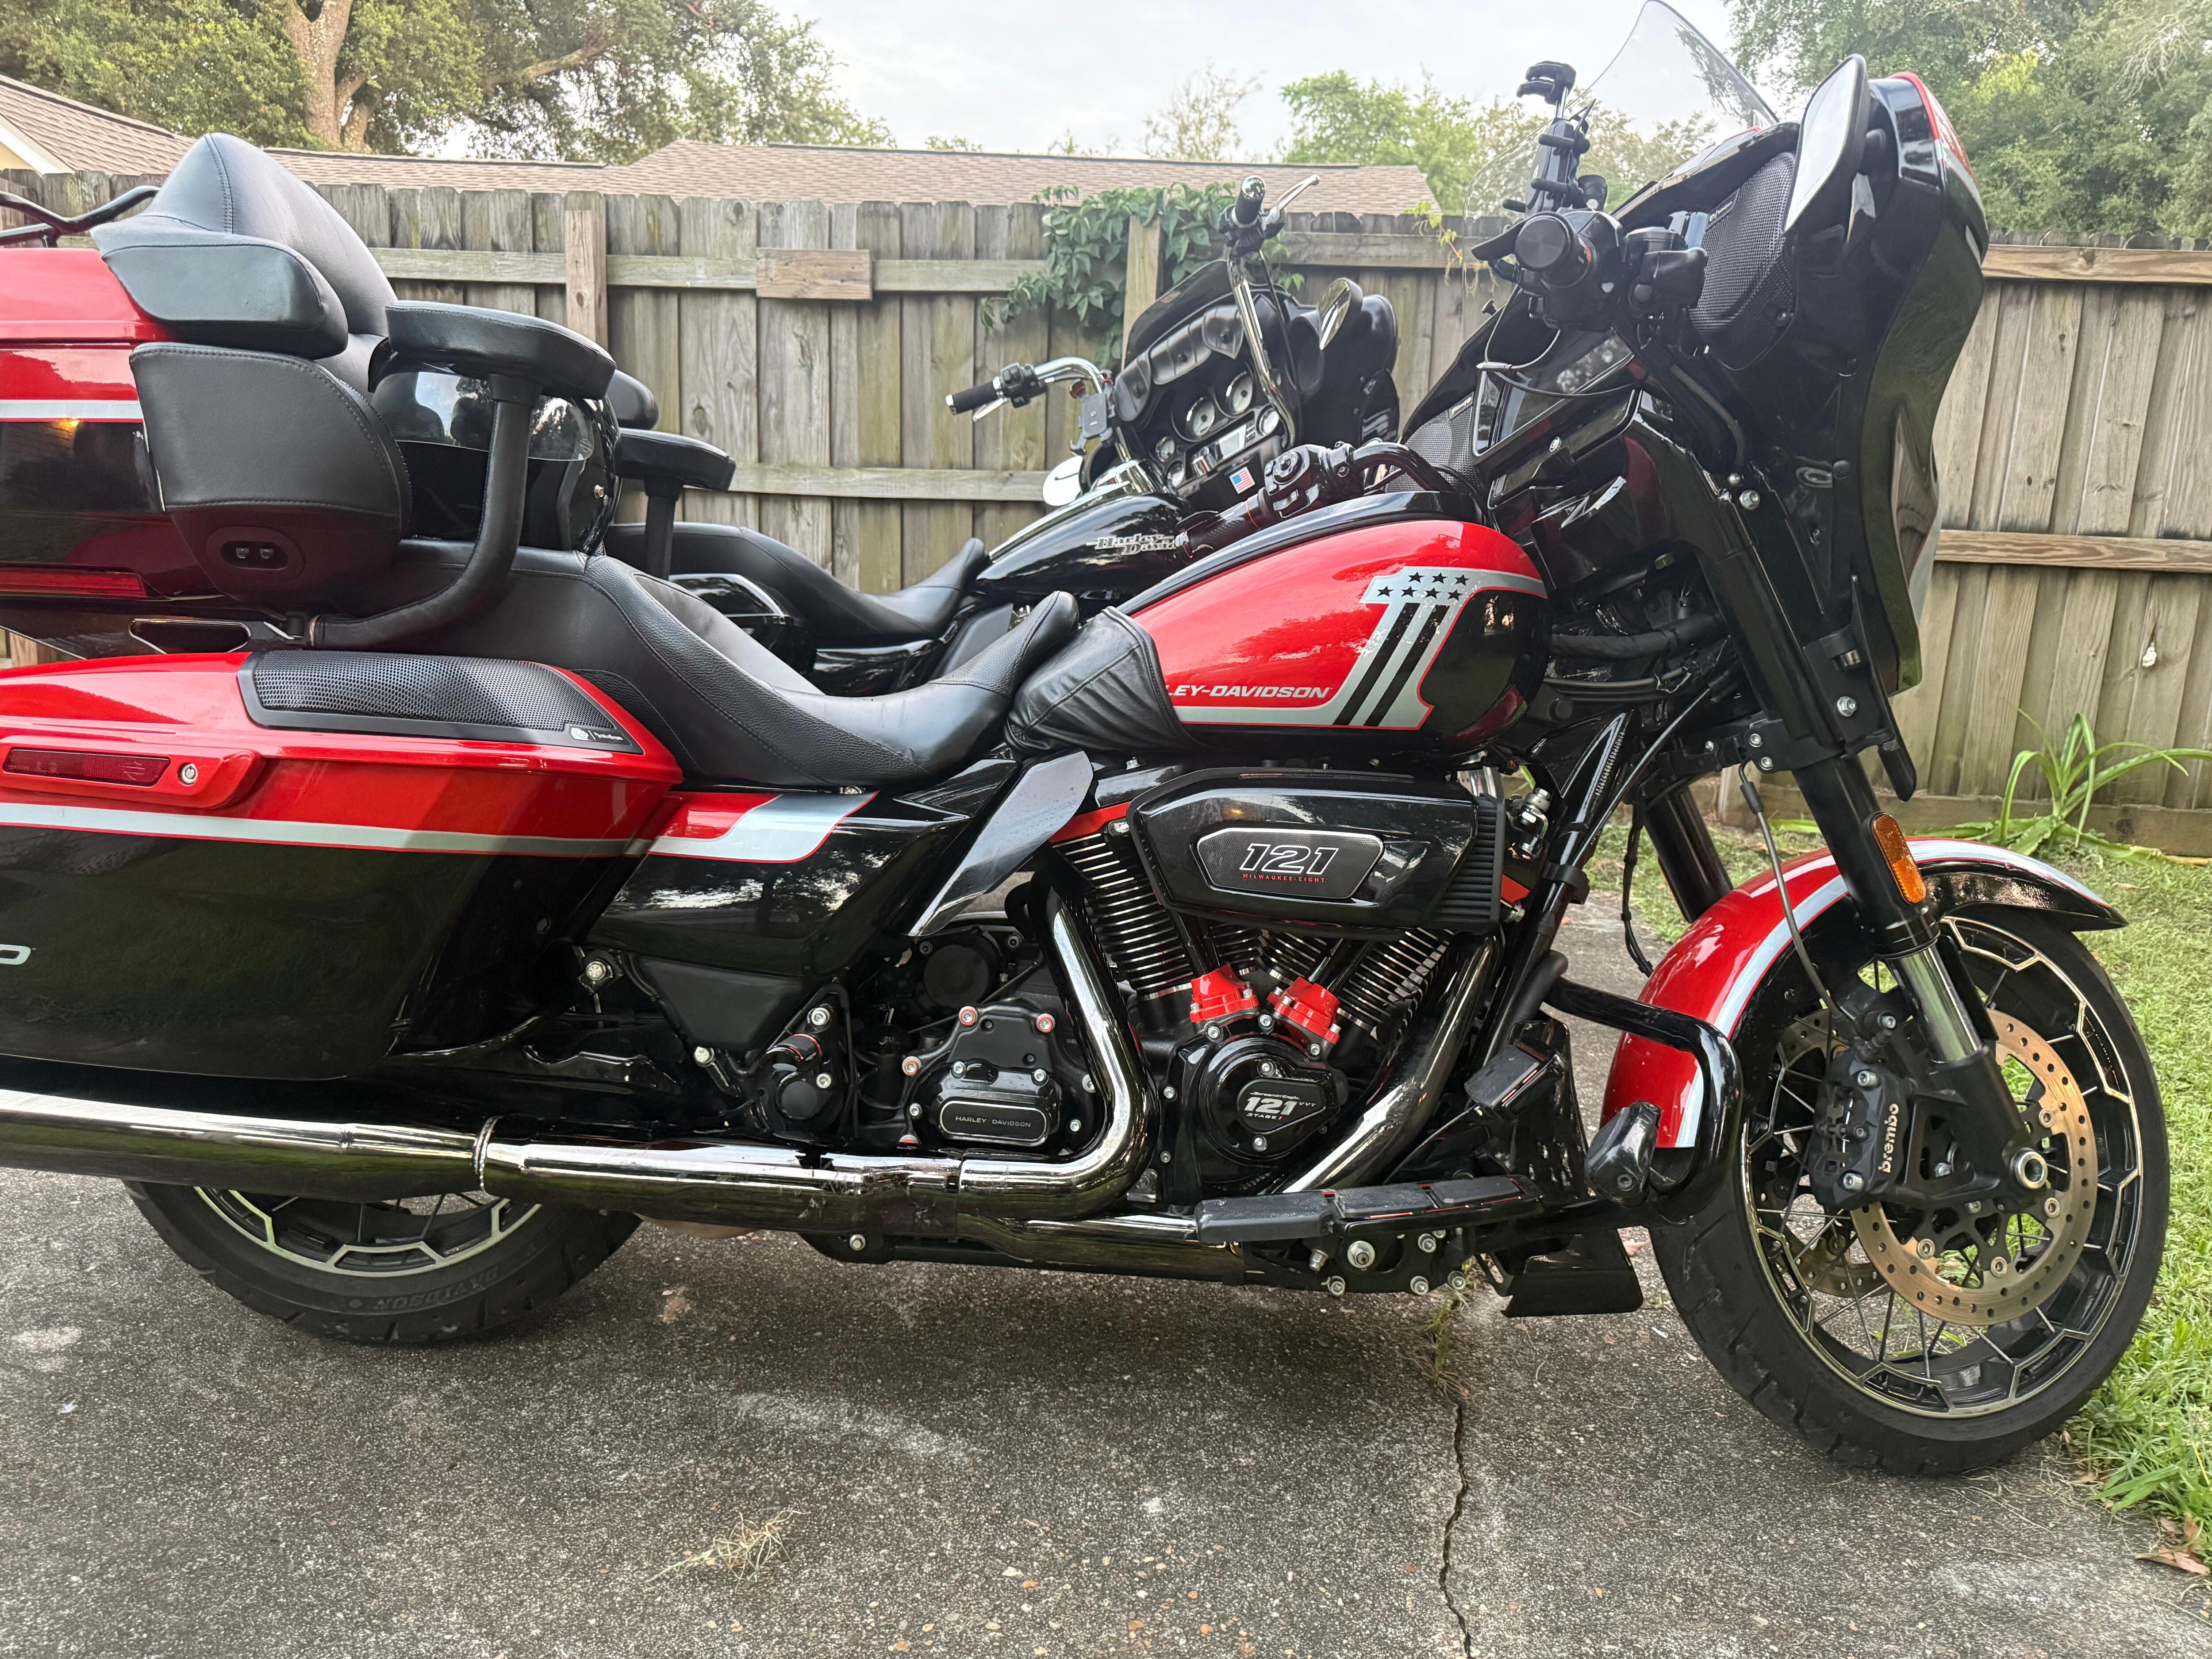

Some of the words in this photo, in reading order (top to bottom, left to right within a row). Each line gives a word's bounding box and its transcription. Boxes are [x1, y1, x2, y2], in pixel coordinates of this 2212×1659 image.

[1087, 533, 1174, 549] Harley
[1239, 843, 1339, 875] 121
[1244, 1097, 1298, 1115] 121
[1878, 1103, 1899, 1173] brembo
